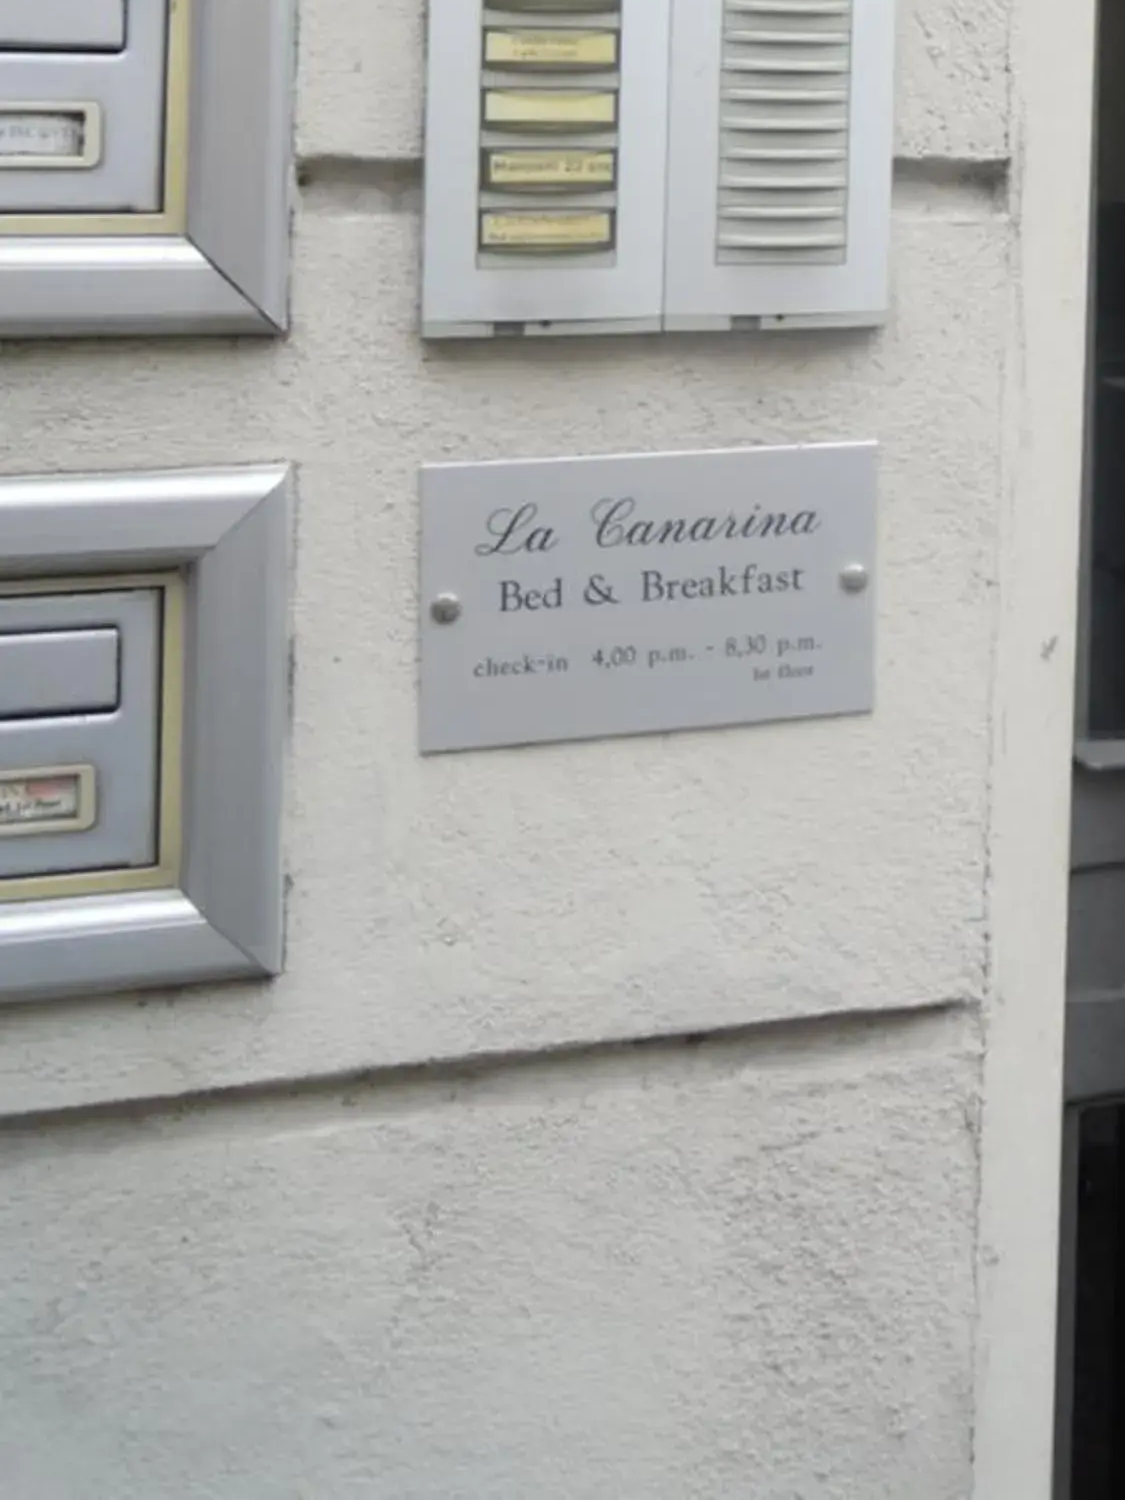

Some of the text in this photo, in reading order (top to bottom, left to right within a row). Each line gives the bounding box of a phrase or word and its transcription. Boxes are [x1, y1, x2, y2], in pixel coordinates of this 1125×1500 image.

[474, 497, 821, 556] La Canarina
[499, 564, 804, 612] Bed & Breakfast
[473, 654, 568, 678] check-in
